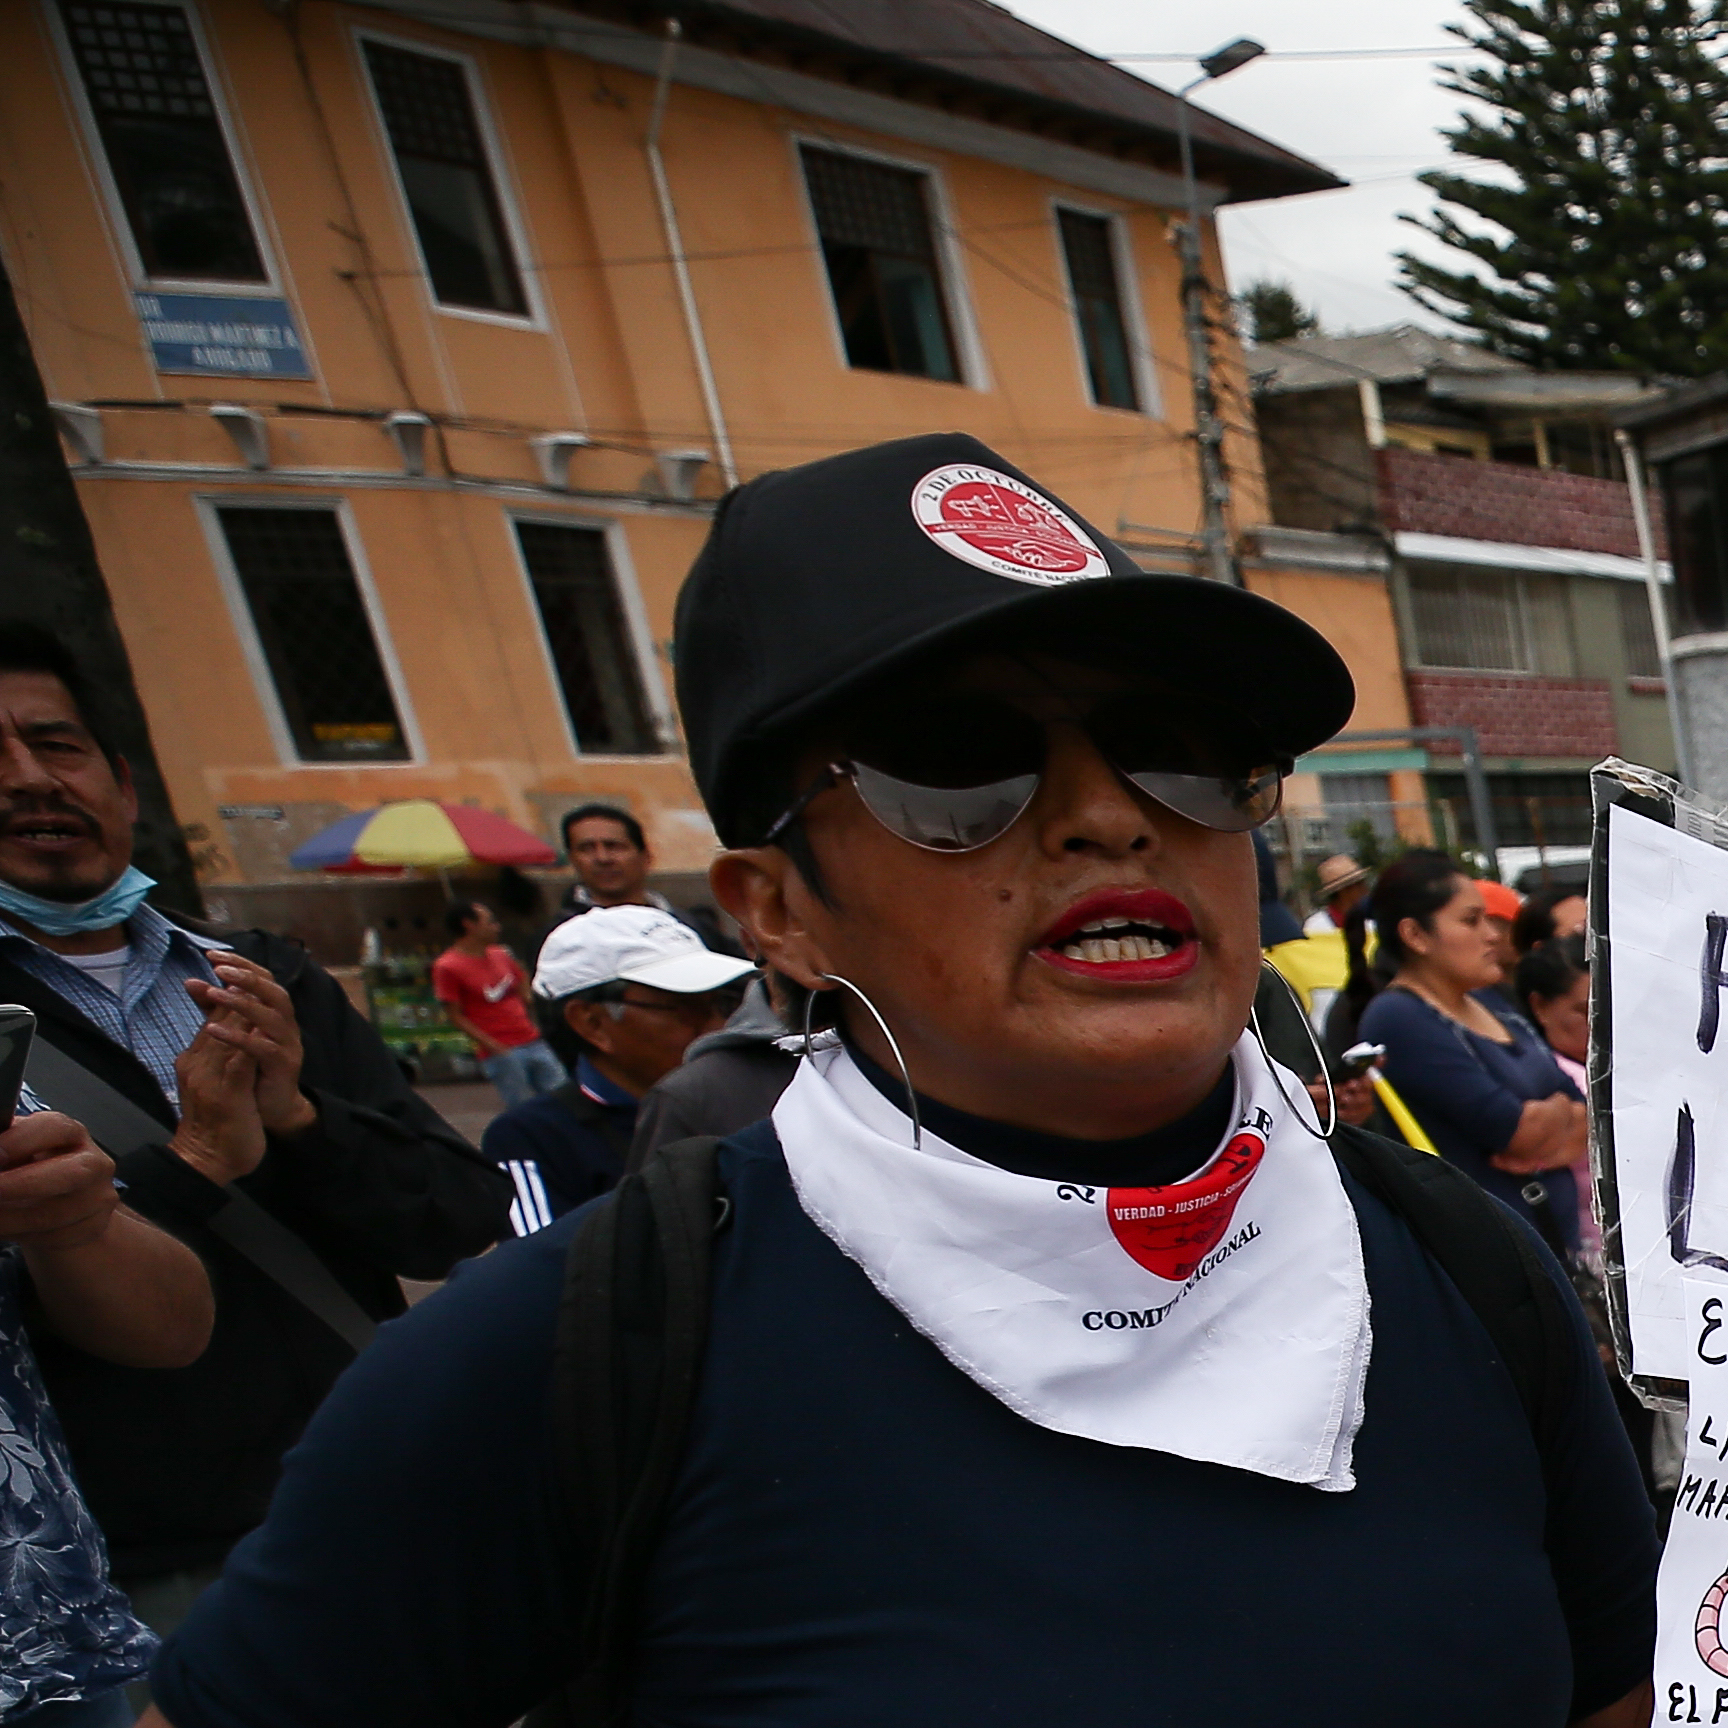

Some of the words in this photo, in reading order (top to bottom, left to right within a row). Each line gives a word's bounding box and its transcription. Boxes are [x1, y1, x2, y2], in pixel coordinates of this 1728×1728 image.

[921, 492, 938, 502] 2
[929, 474, 956, 492] DE
[1113, 1205, 1166, 1221] VERDAD
[1174, 1191, 1219, 1214] JUSTICIA
[1182, 1220, 1262, 1297] NACIONAL
[1667, 1681, 1702, 1724] EL
